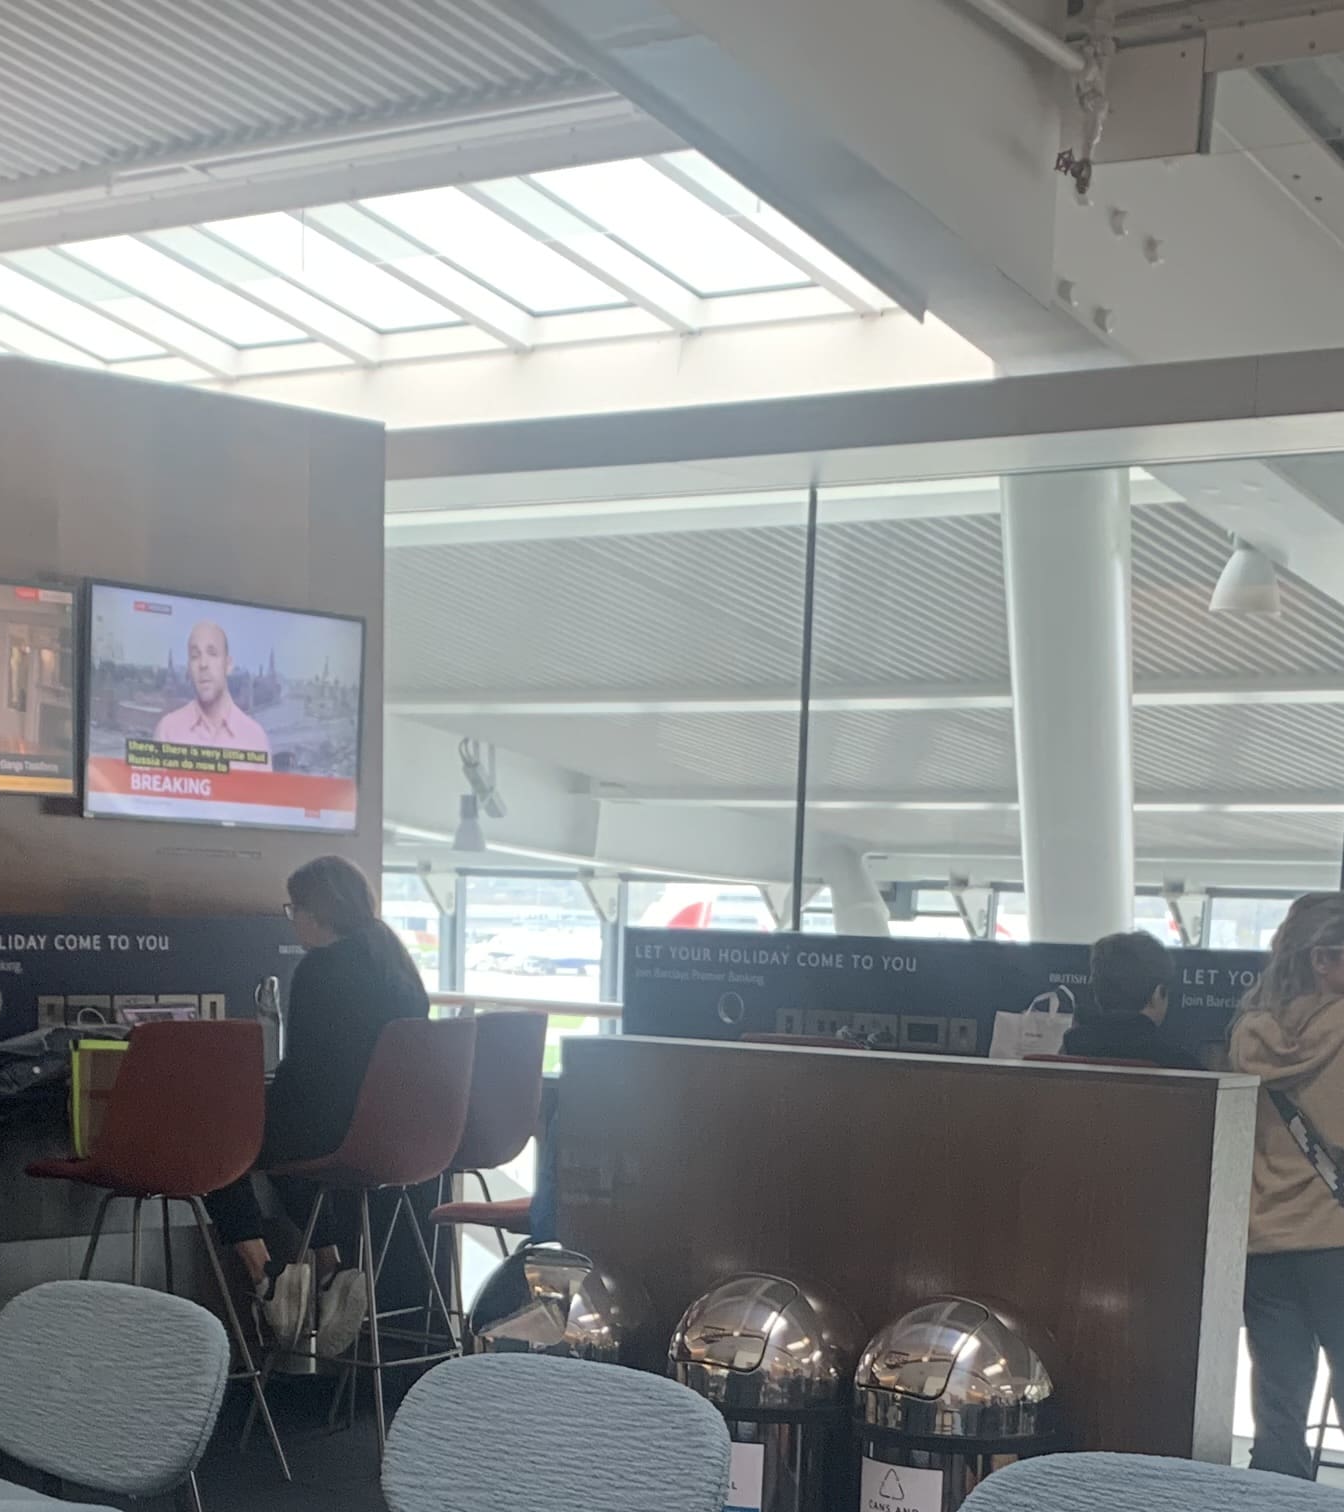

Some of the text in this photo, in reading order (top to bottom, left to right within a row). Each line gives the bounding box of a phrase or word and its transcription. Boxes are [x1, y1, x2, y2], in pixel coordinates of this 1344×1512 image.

[130, 772, 212, 797] BREAKING
[54, 934, 101, 950] COME
[108, 934, 130, 950] TO
[136, 934, 170, 950] YOU
[635, 945, 917, 973] LET YOUR HOLIDAY COME TO YOU
[1182, 967, 1219, 985] LET
